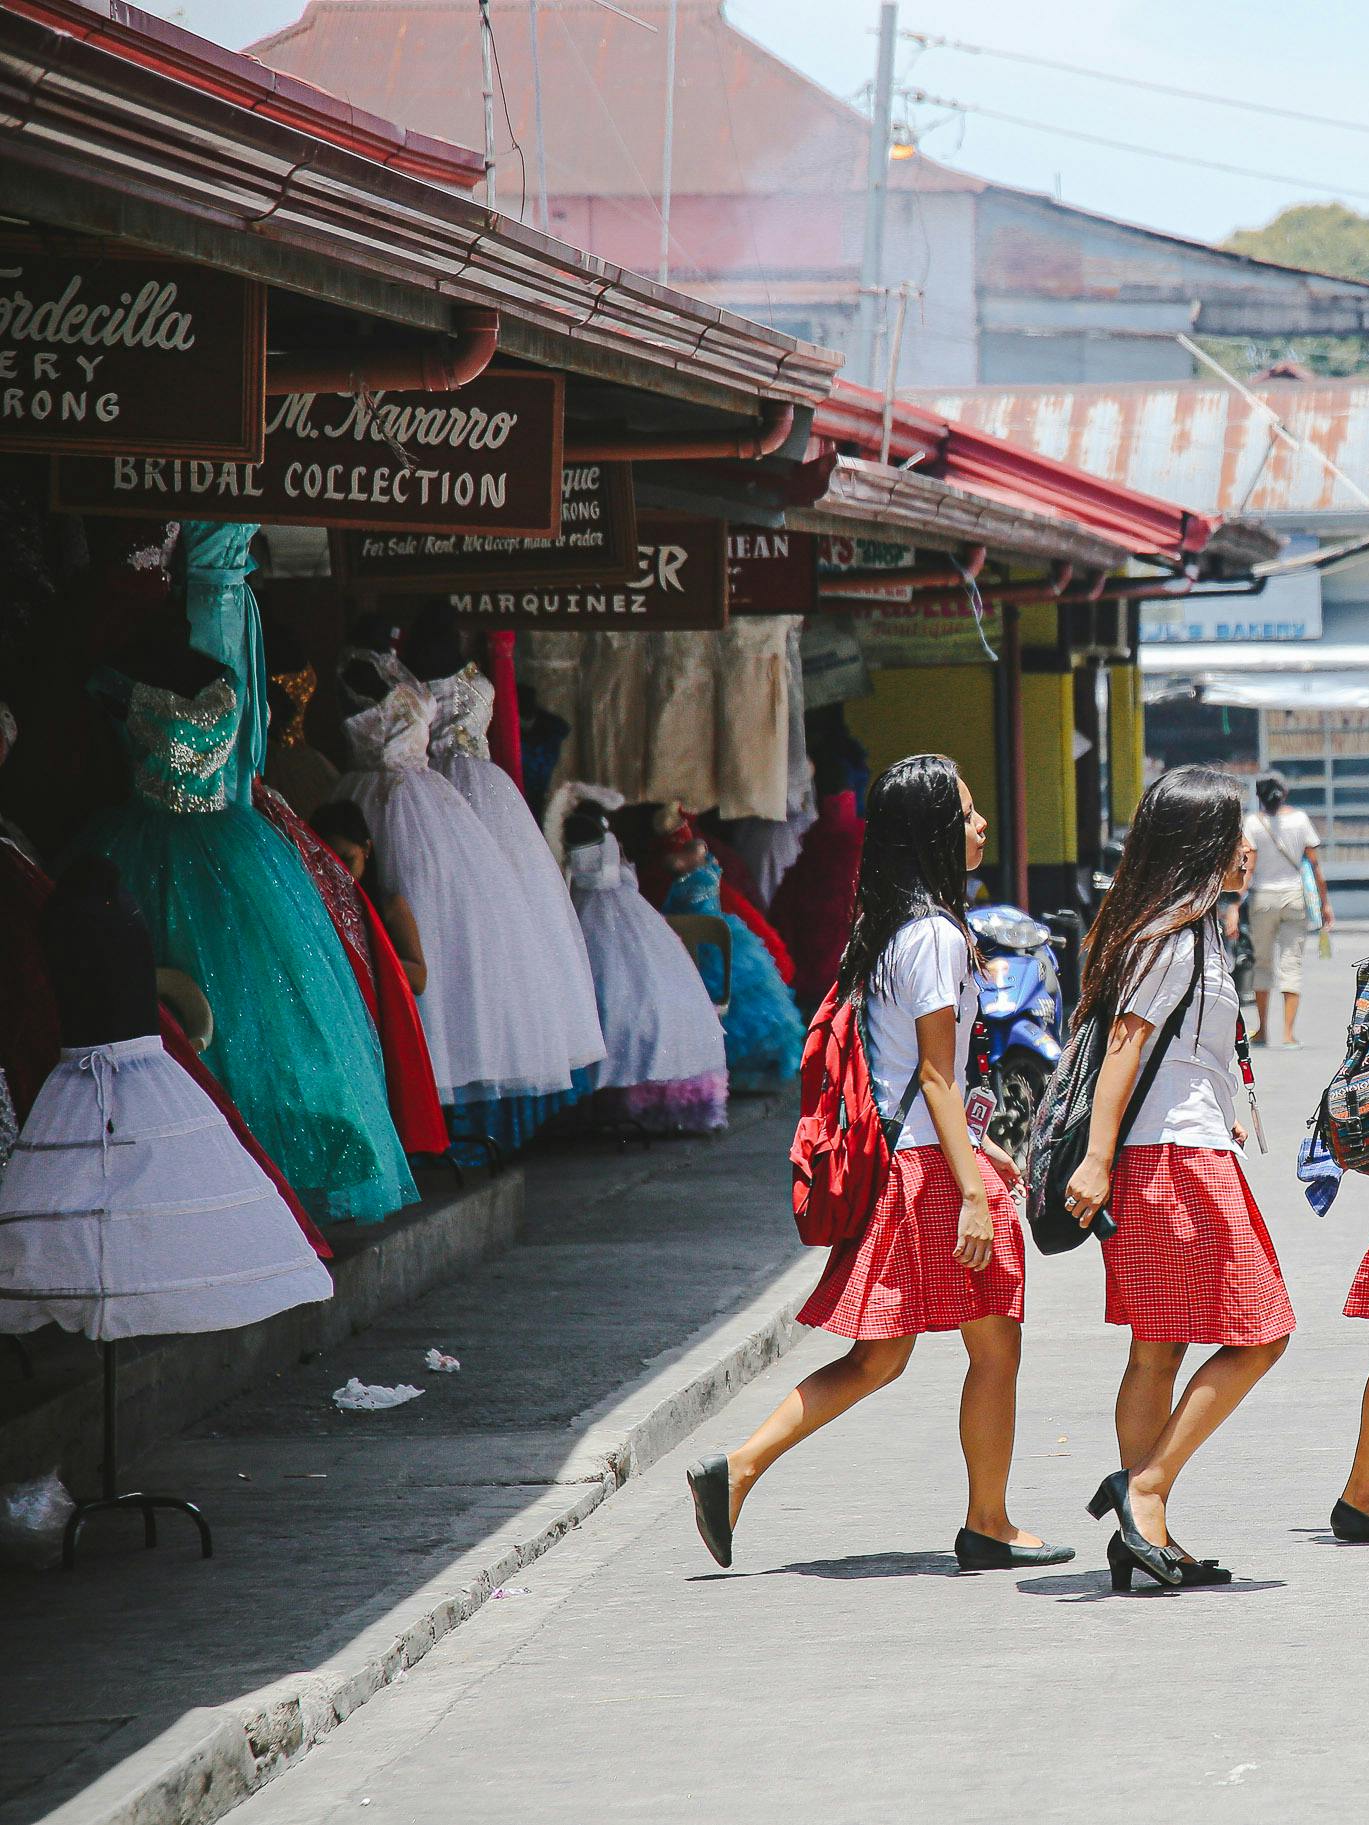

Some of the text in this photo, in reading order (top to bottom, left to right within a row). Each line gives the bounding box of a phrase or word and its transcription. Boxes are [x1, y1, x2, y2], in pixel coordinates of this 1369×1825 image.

[325, 389, 517, 449] Navarro
[114, 457, 508, 508] BRIDAL COLLECTION
[1214, 623, 1305, 641] BAKERY
